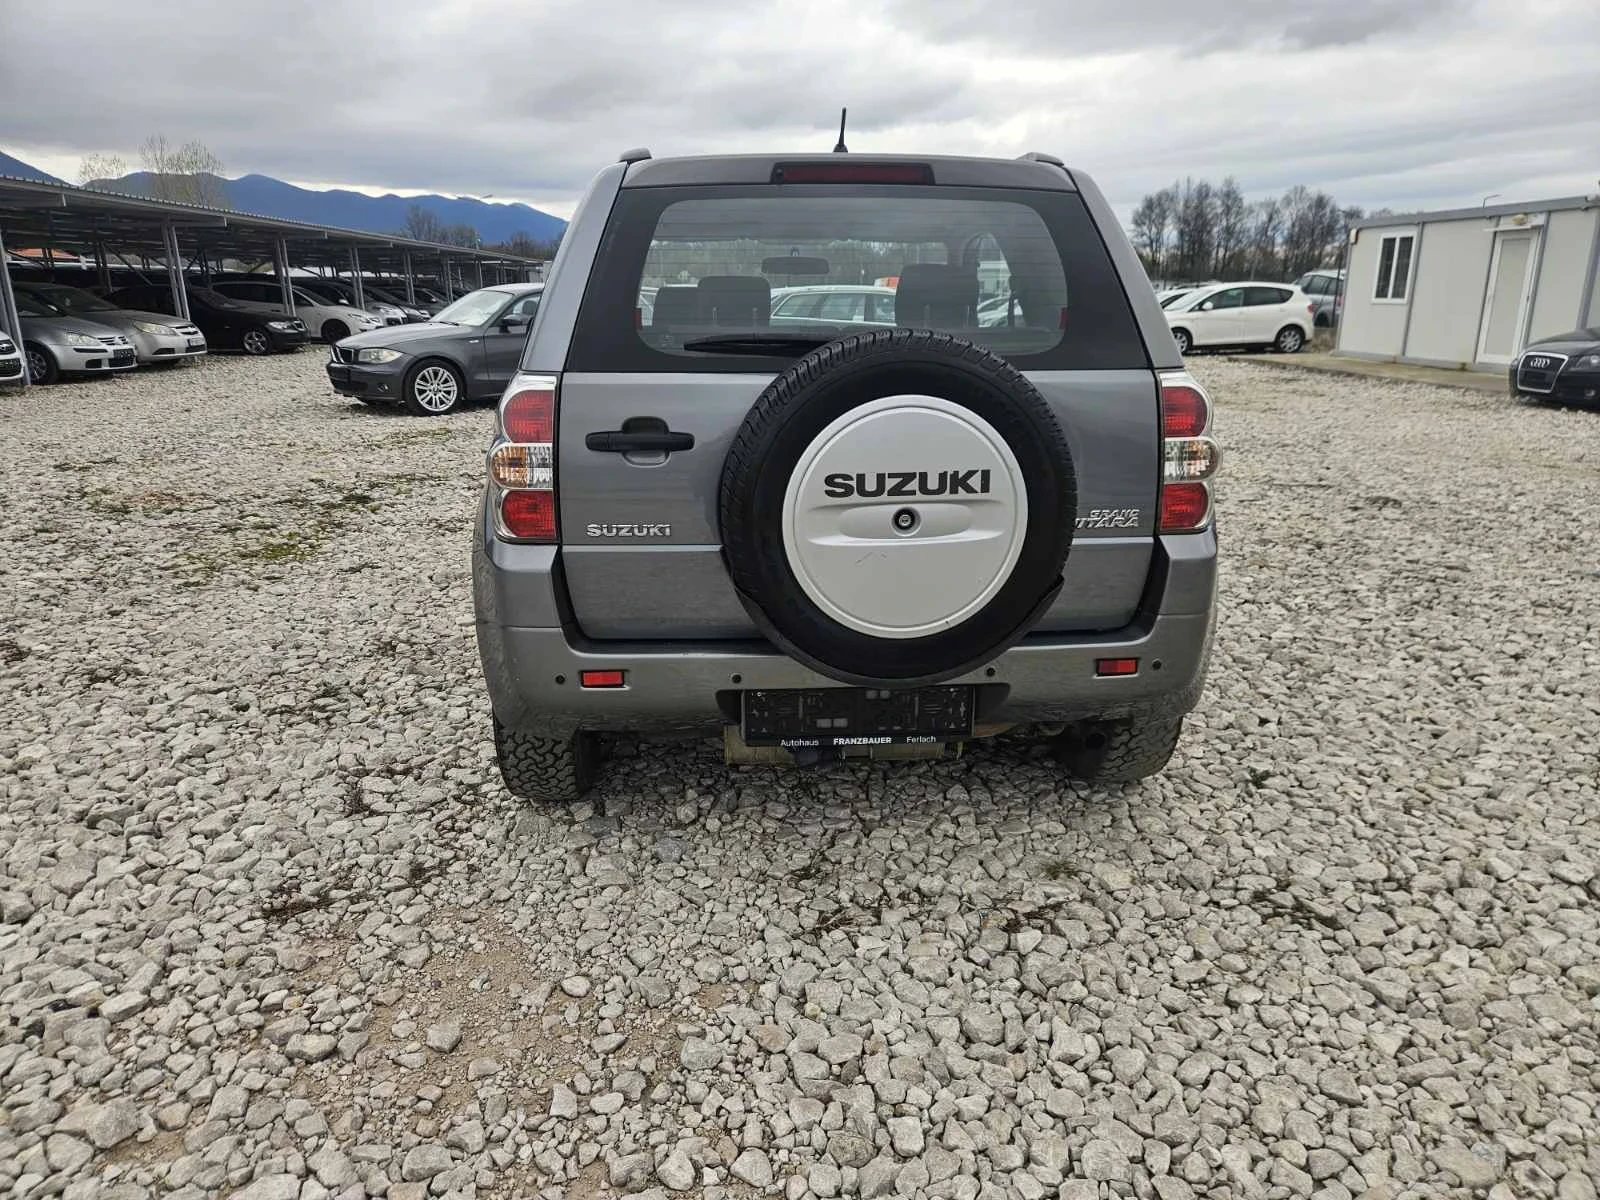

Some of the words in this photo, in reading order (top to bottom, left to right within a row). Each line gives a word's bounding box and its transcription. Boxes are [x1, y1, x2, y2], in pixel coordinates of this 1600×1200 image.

[824, 469, 991, 498] SUZUKI
[1074, 517, 1139, 529] ITARA
[586, 523, 672, 537] SUZUKI
[780, 738, 820, 747] Autohaus
[833, 736, 892, 746] FRANZBAUER
[906, 735, 937, 744] Ferlach
